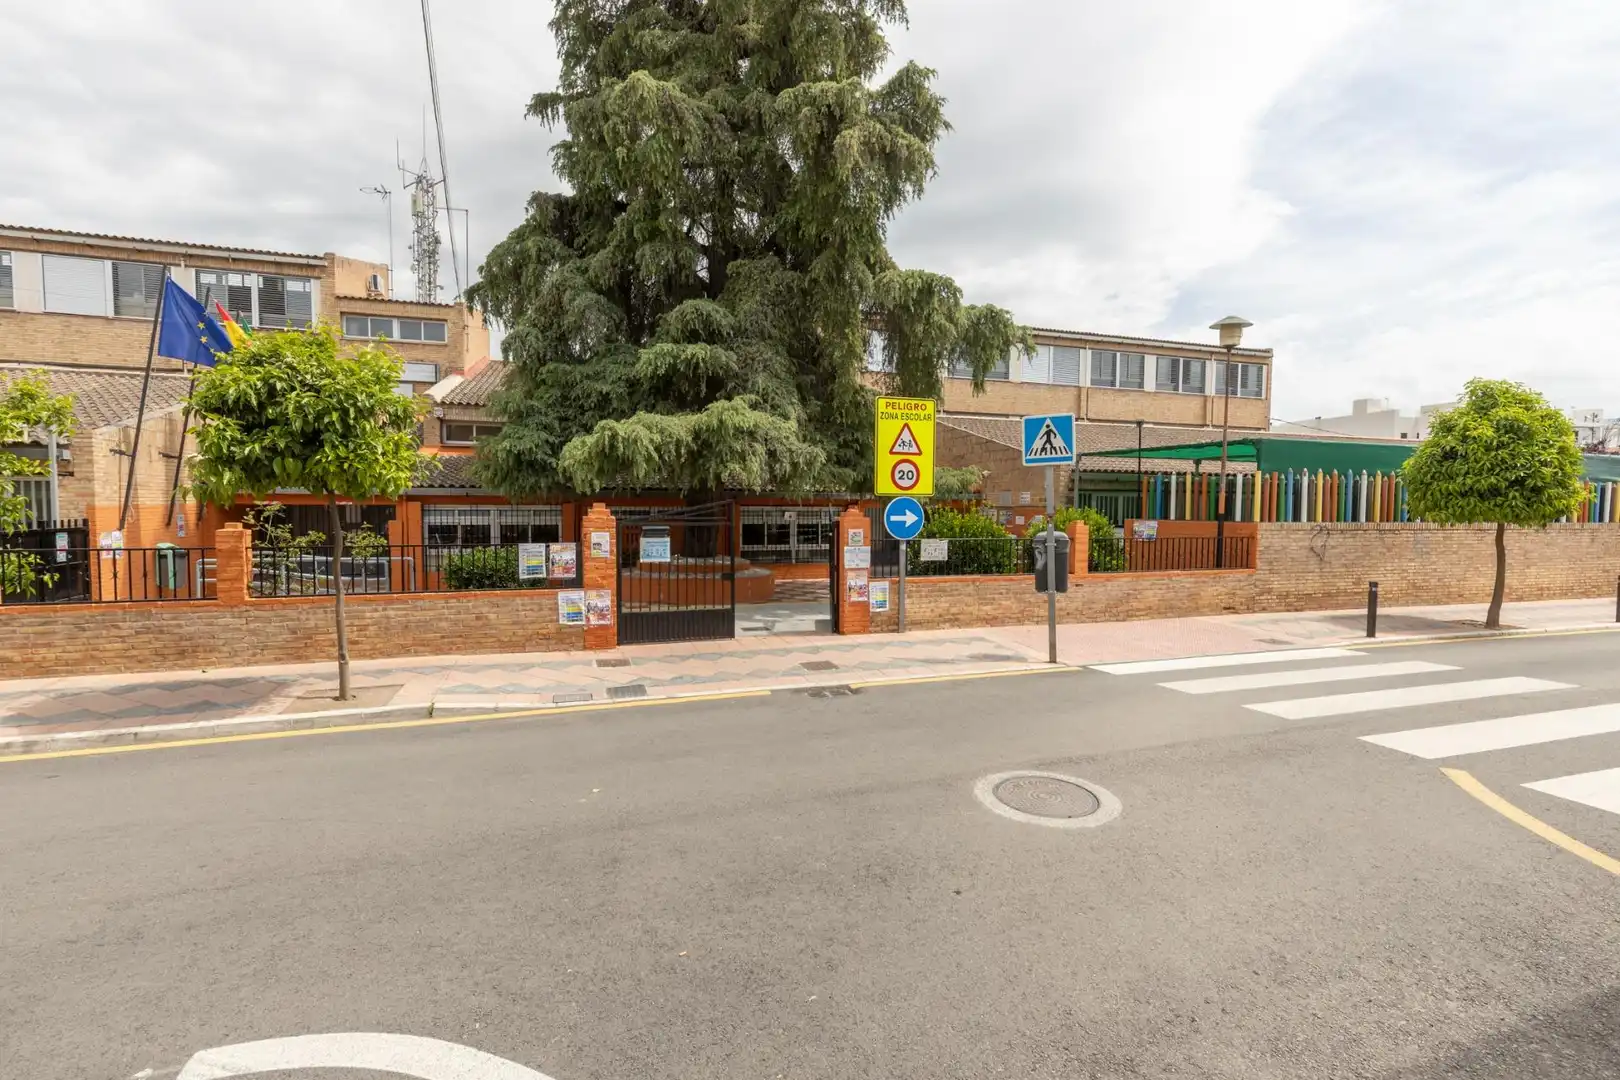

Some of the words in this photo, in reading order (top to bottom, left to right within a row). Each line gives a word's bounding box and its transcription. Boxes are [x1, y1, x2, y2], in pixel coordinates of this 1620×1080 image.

[885, 401, 928, 411] PELIGRO
[880, 411, 899, 420] ZONA
[900, 412, 933, 421] ESCOLAR
[898, 469, 914, 480] 20
